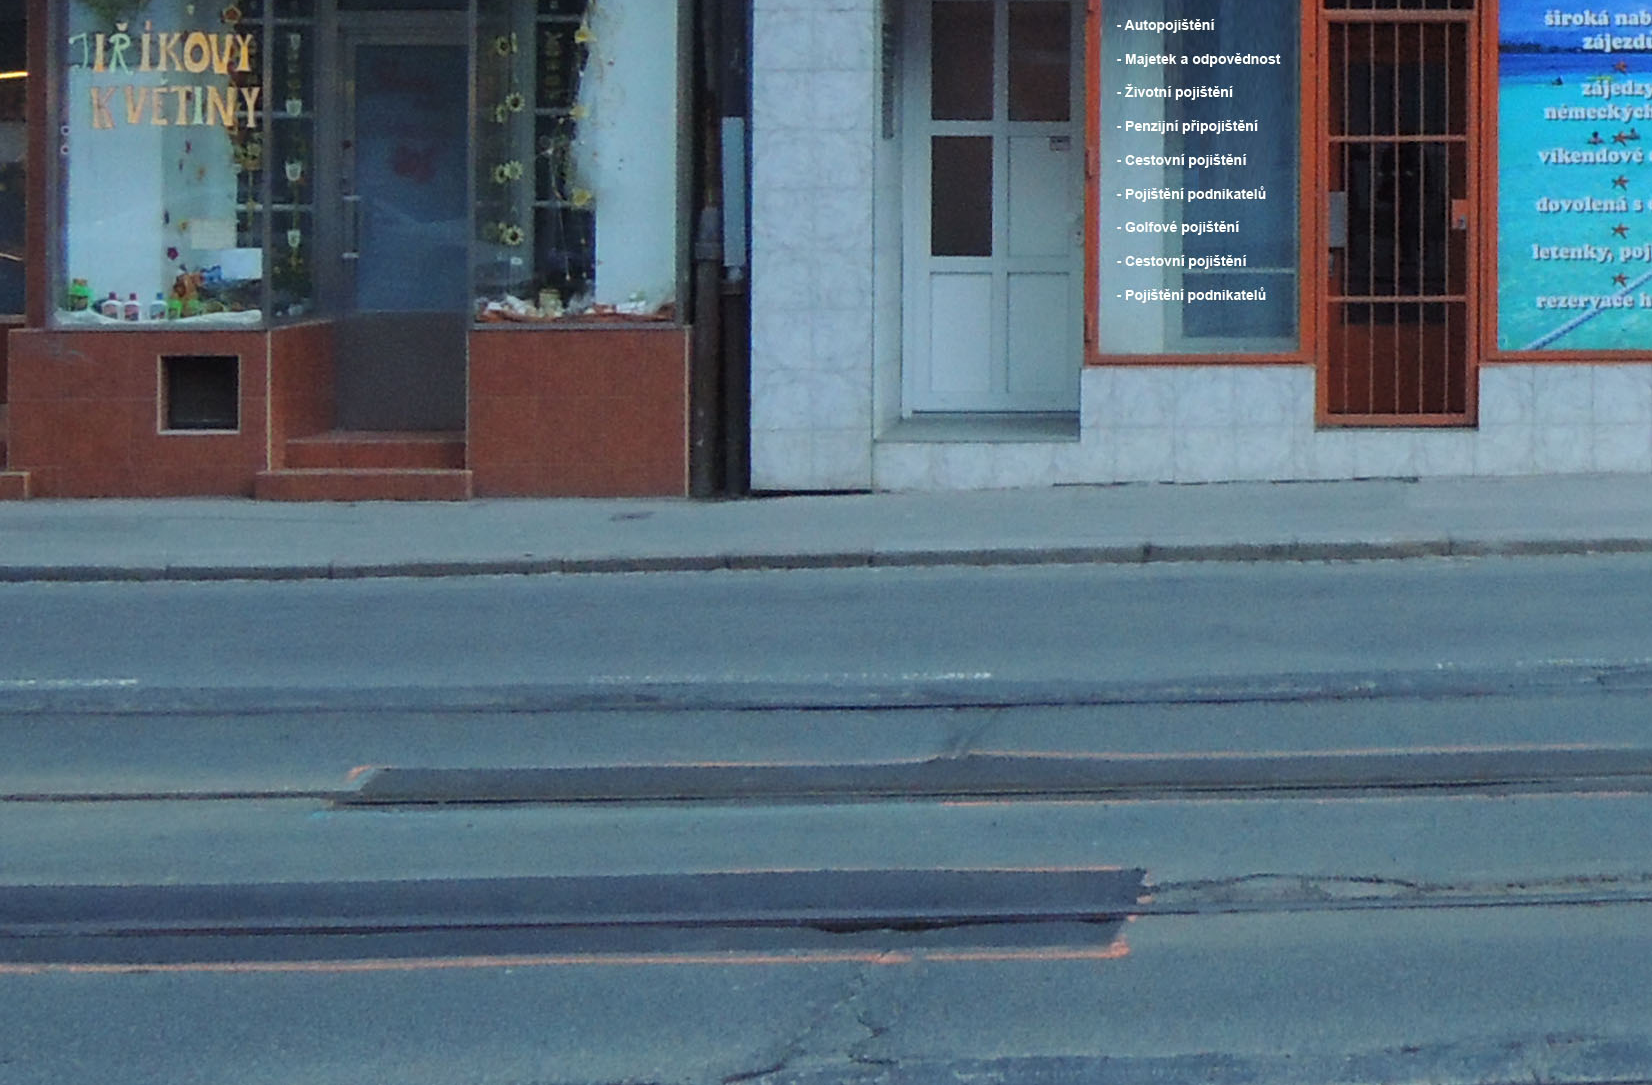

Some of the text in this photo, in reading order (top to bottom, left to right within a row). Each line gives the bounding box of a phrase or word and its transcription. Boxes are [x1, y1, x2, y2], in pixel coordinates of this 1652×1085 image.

[1124, 19, 1215, 34] Autopojištění
[1544, 10, 1611, 27] široká
[1125, 53, 1177, 68] Majetek
[1180, 55, 1189, 65] a
[1192, 52, 1281, 68] odpovědnost
[1124, 84, 1172, 98] Životní
[1175, 86, 1234, 101] pojištění
[1125, 120, 1179, 135] Penzijní
[1182, 120, 1258, 135] připojištění
[1125, 153, 1185, 166] Cestovní
[1188, 153, 1247, 169] pojištění
[1125, 187, 1184, 203] Pojištění
[1187, 185, 1266, 203] podnikatelů
[1536, 196, 1629, 213] dovolená
[1633, 200, 1644, 213] s
[1125, 220, 1178, 233] Golfové
[1181, 220, 1240, 236] pojištění
[1125, 254, 1185, 267] Cestovní
[1188, 254, 1247, 270] pojištění
[1125, 288, 1184, 304] Pojištění
[1187, 286, 1266, 304] podnikatelů
[1536, 294, 1636, 310] rezervace
